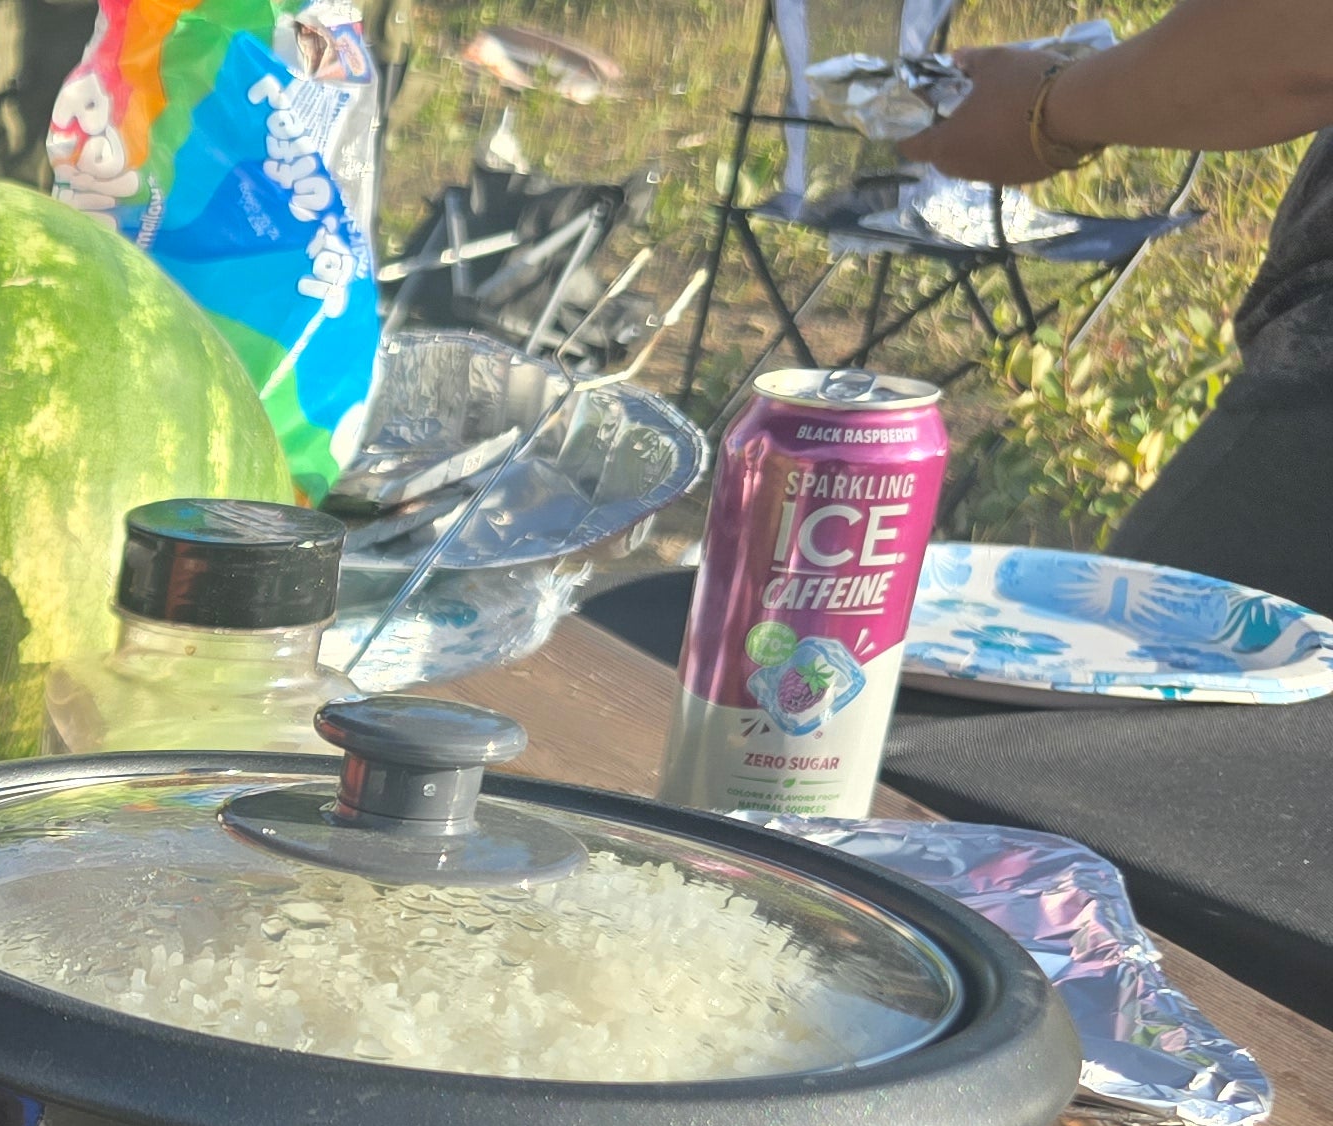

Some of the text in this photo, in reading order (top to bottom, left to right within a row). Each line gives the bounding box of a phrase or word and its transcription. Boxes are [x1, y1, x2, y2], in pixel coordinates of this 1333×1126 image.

[796, 424, 918, 445] BLACK RASPBERRY
[785, 471, 916, 500] SPARKLING
[771, 501, 910, 568] ICE
[762, 570, 894, 611] CAFFEINE
[743, 752, 841, 771] ZERO SUGAR
